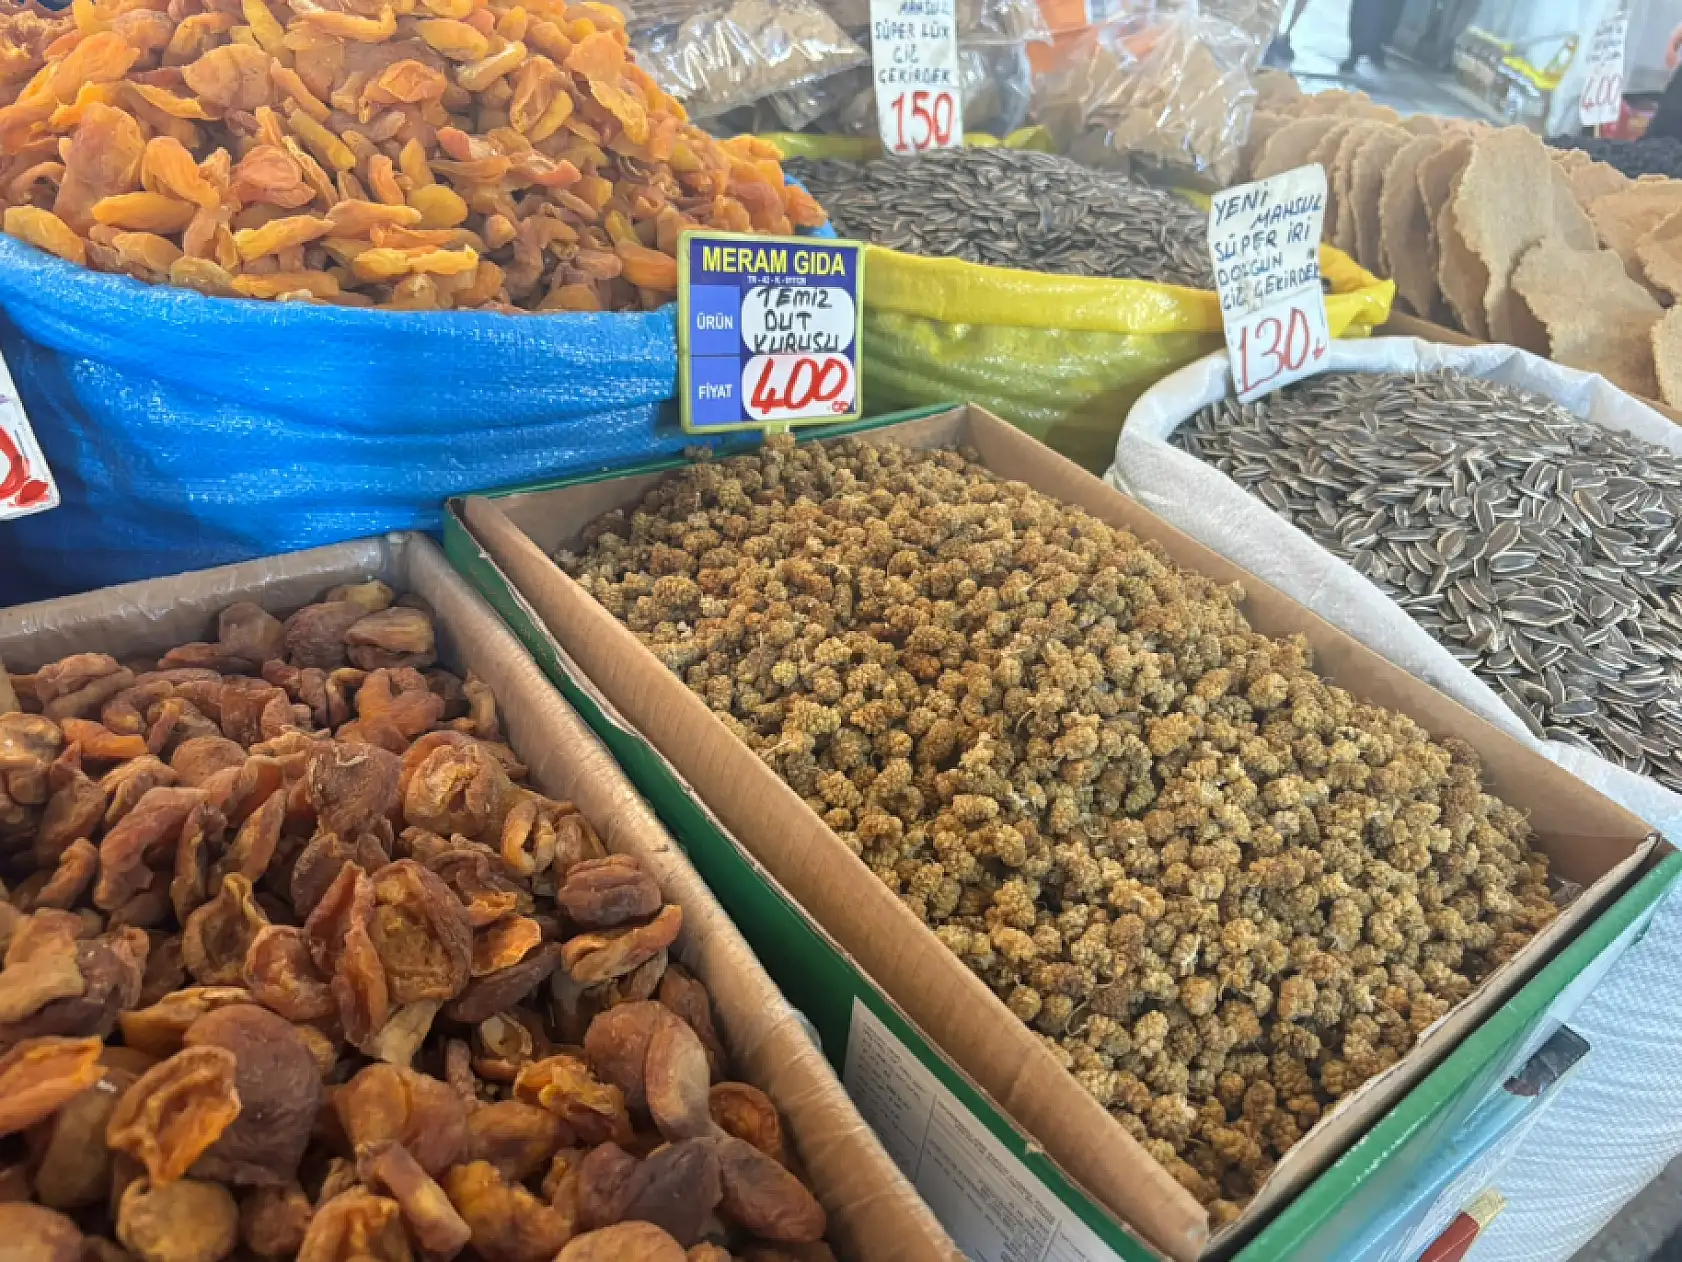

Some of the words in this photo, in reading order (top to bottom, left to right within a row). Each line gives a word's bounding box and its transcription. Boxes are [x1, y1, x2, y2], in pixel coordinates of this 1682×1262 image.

[875, 18, 916, 40] SÜPER
[891, 91, 953, 151] 150
[1214, 229, 1278, 262] SÜPER
[702, 246, 788, 273] MERAM
[794, 251, 846, 276] GIDA
[696, 312, 734, 330] ÜRÜN
[754, 331, 840, 353] KURUSU
[698, 382, 734, 400] FİYAT
[750, 356, 849, 414] 400
